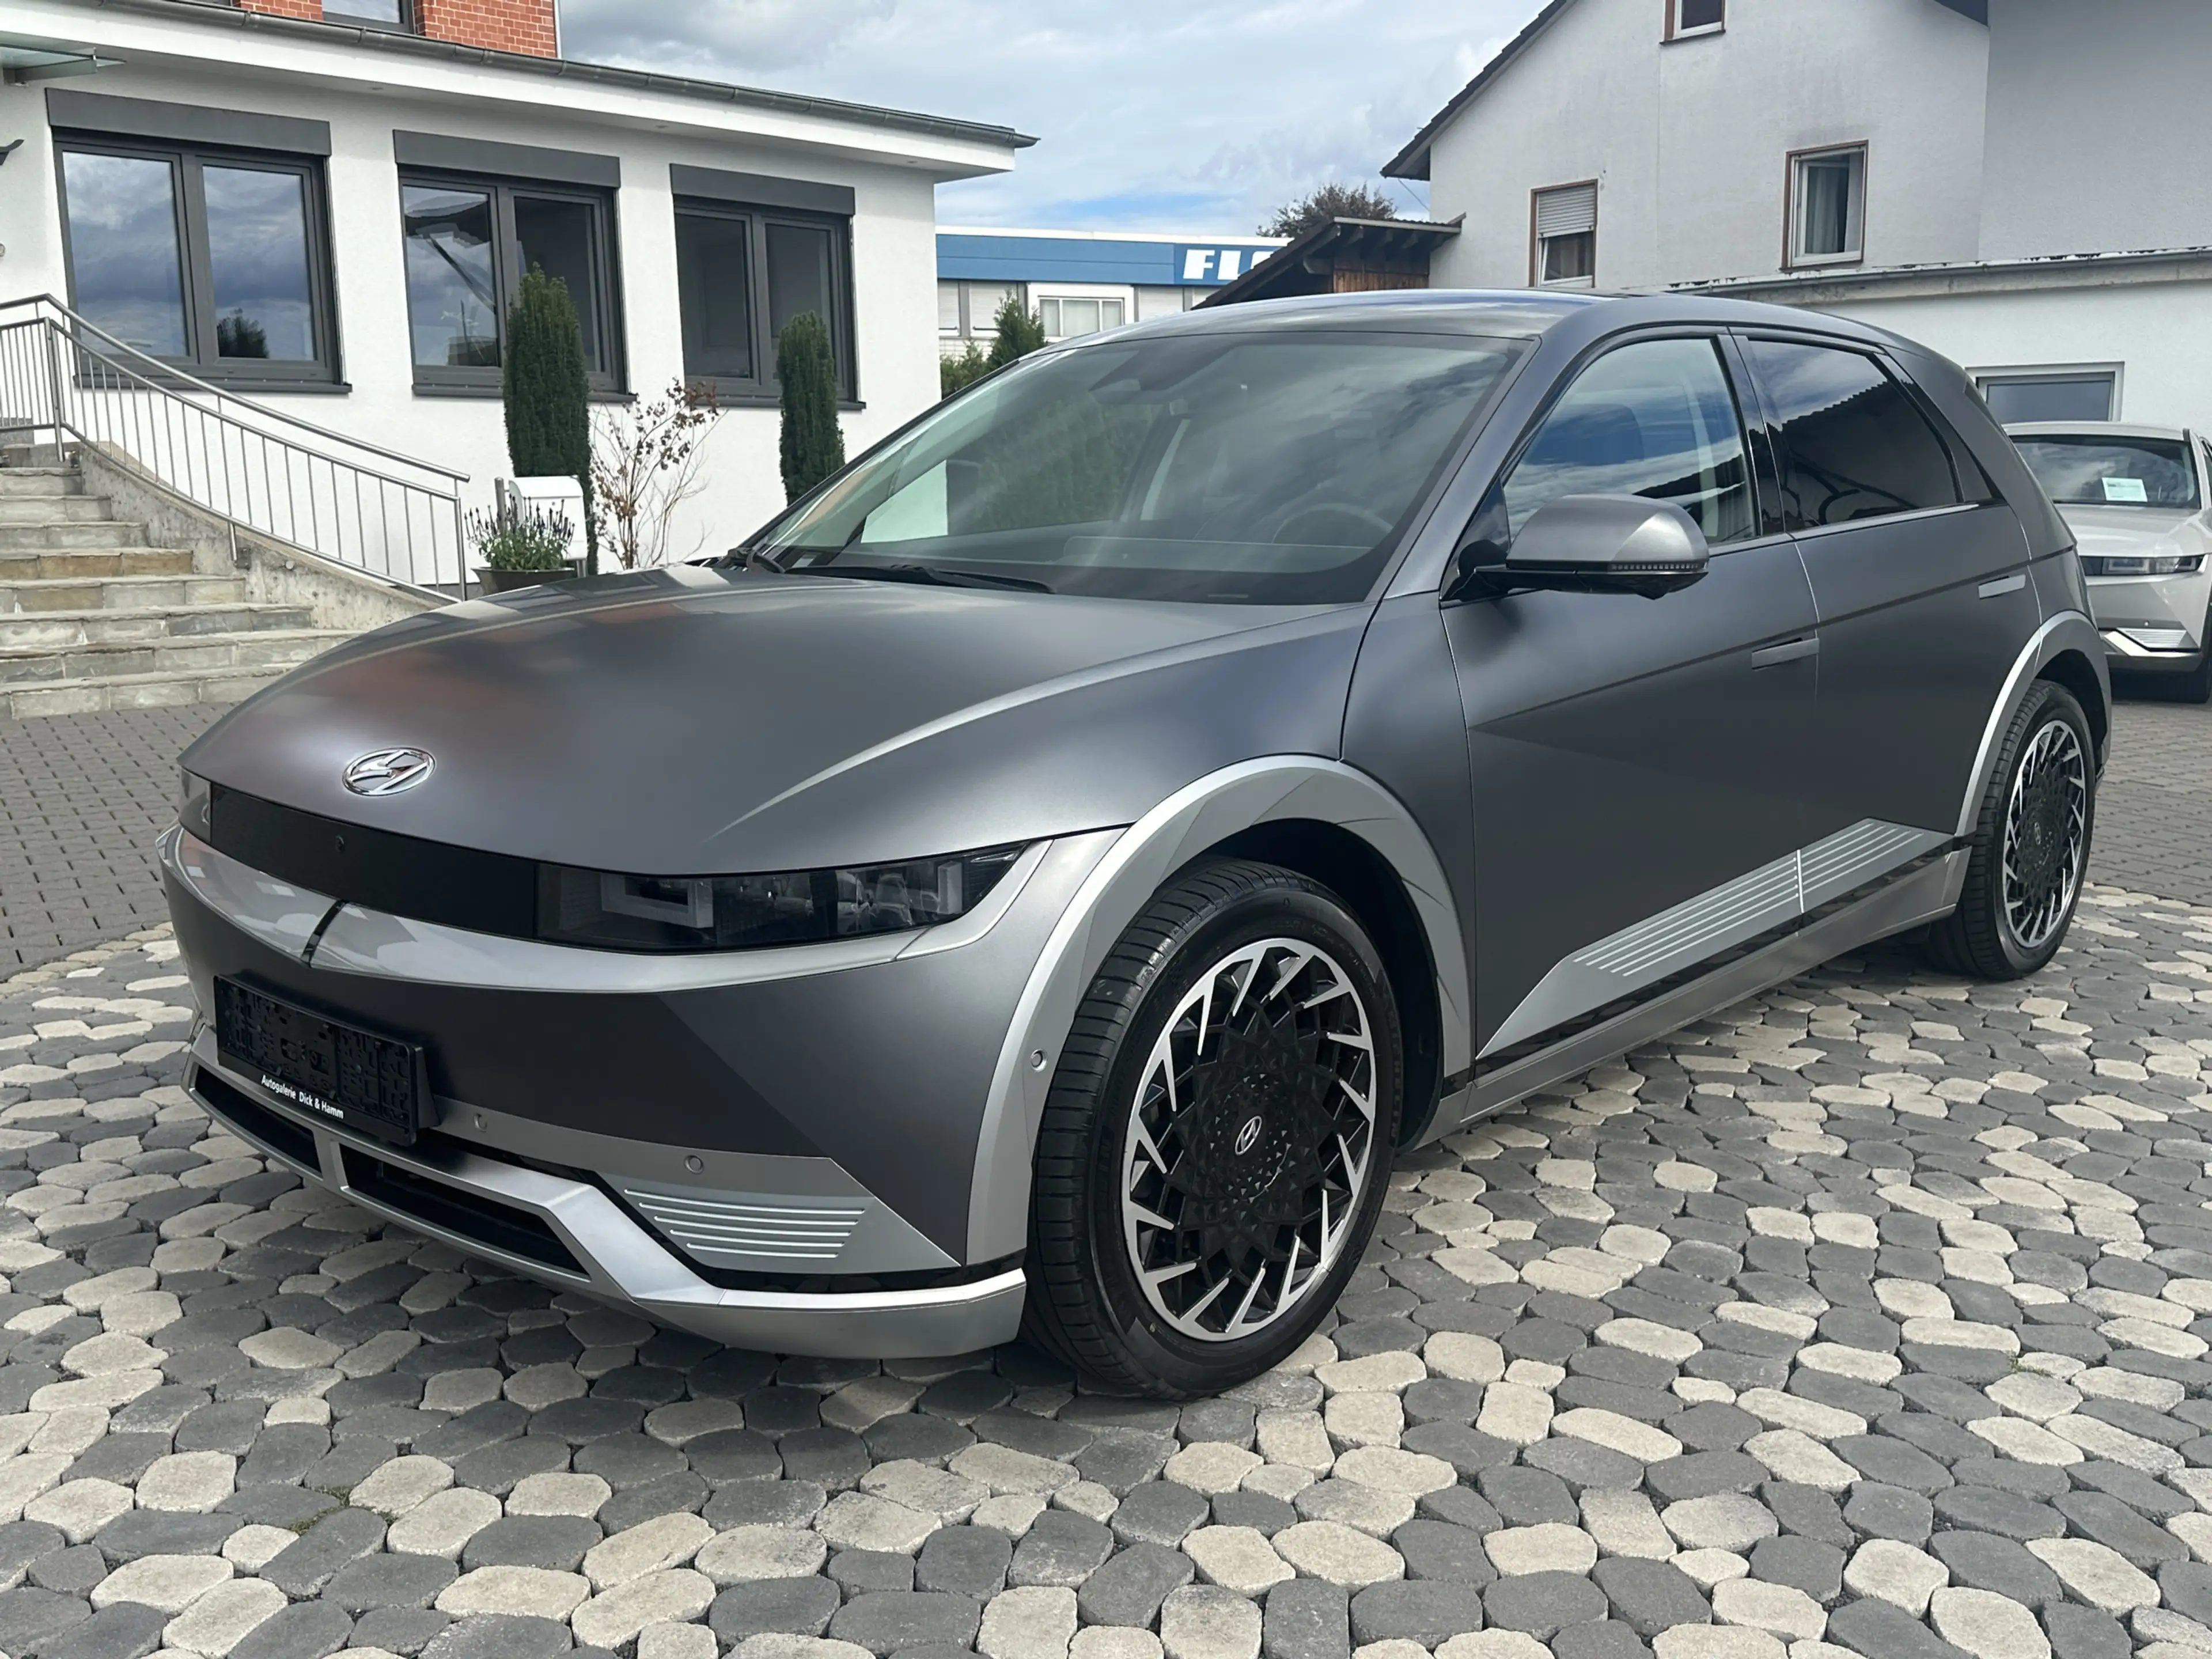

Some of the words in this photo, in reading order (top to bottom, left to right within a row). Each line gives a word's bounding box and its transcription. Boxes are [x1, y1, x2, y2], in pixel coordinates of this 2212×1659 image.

[261, 1074, 296, 1100] Autogalerie
[298, 1091, 313, 1107] Dick
[314, 1098, 320, 1109] &
[321, 1101, 344, 1119] Hamm
